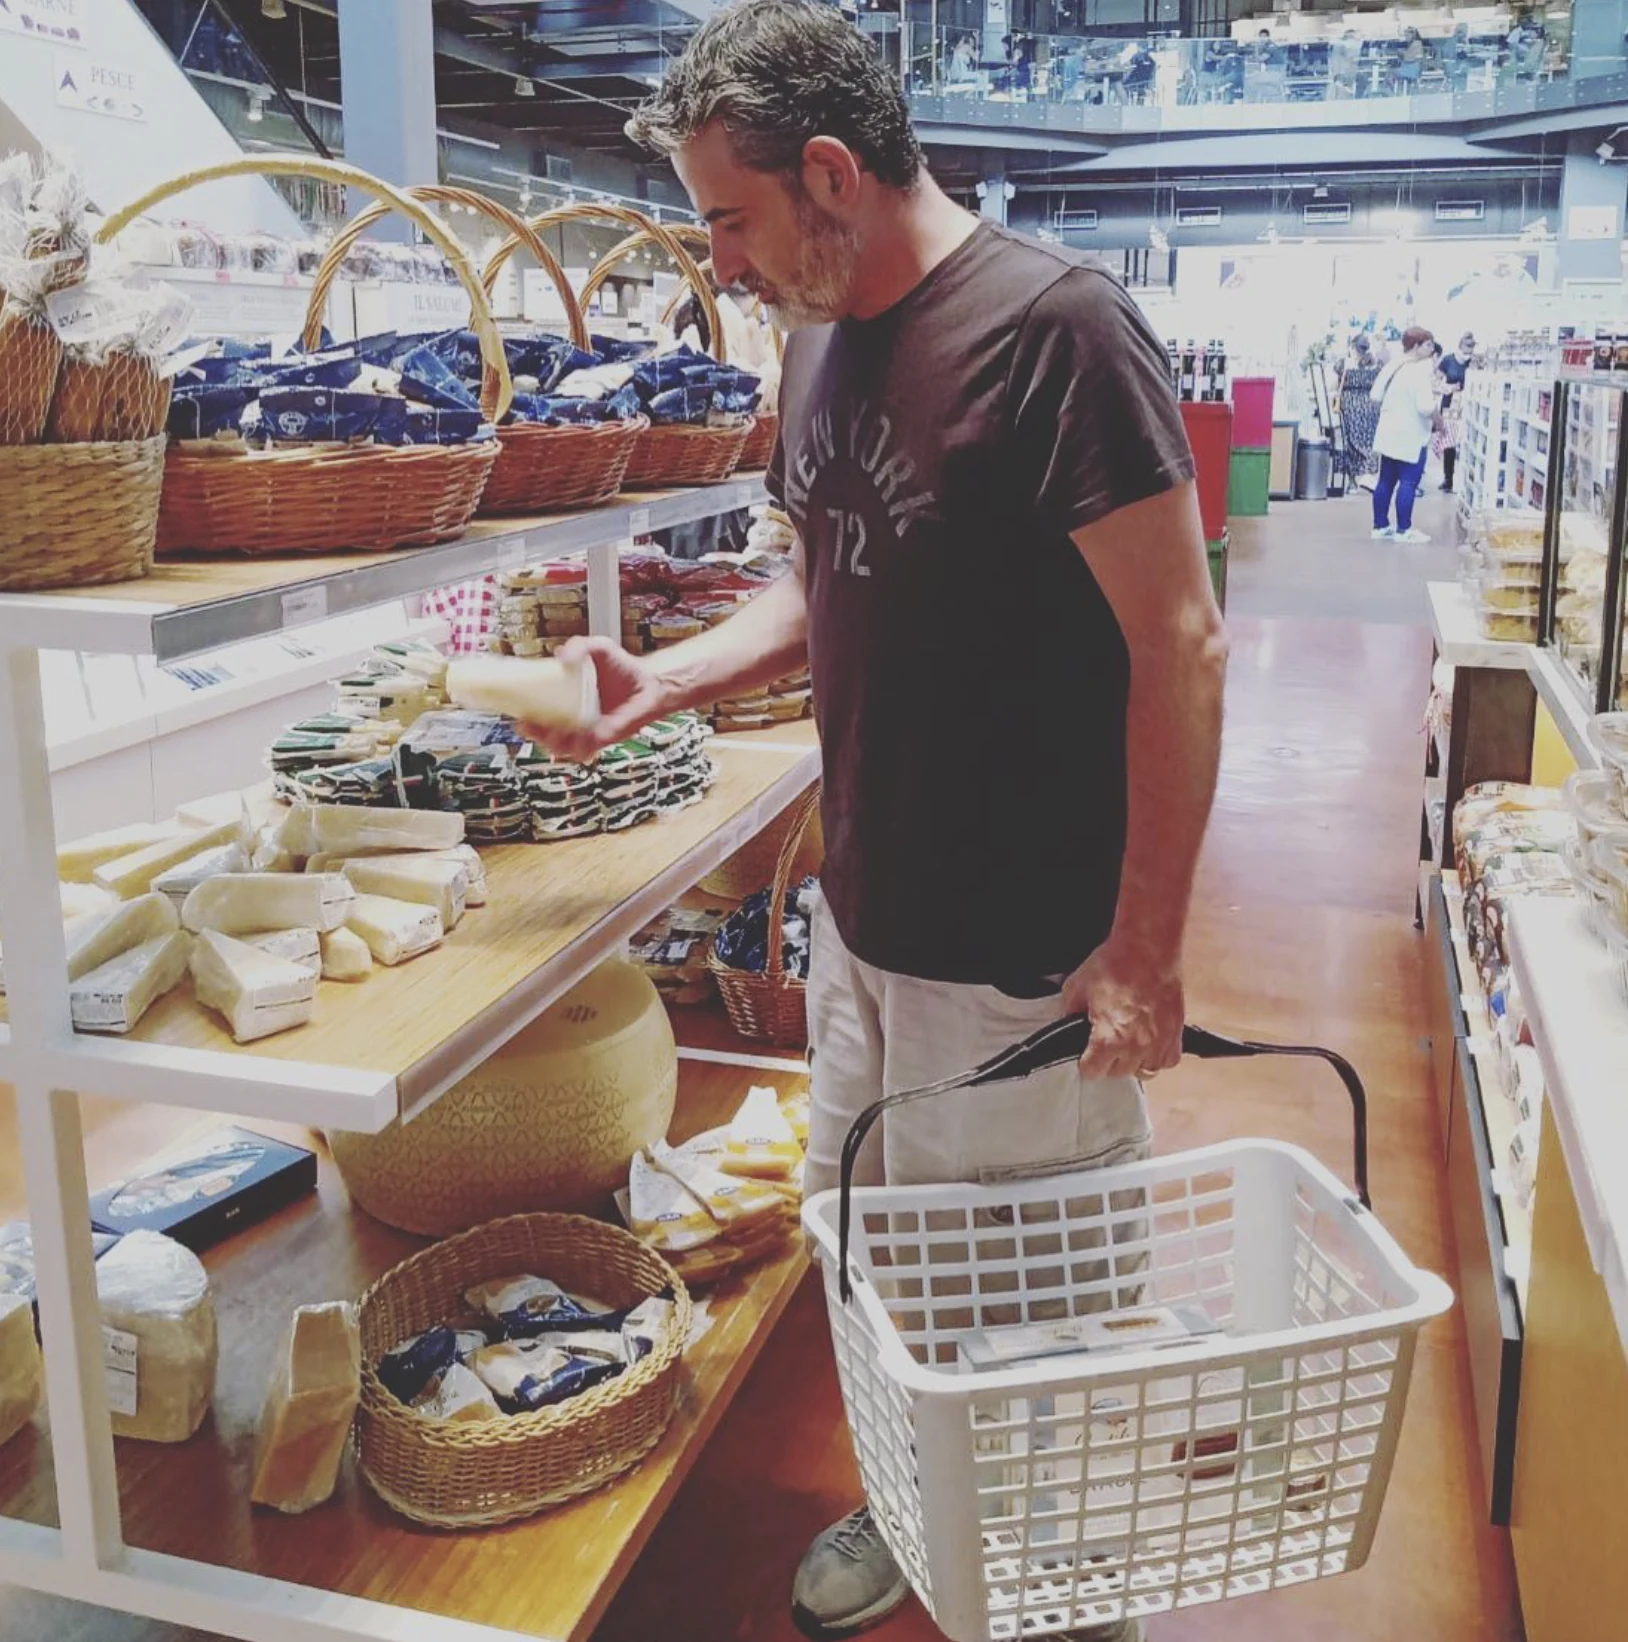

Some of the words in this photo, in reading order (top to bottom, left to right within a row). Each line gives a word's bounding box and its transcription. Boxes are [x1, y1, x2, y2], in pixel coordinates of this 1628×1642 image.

[90, 65, 135, 91] PESCE
[785, 404, 836, 520] NEW
[849, 397, 946, 538] YORK
[825, 506, 872, 577] 72
